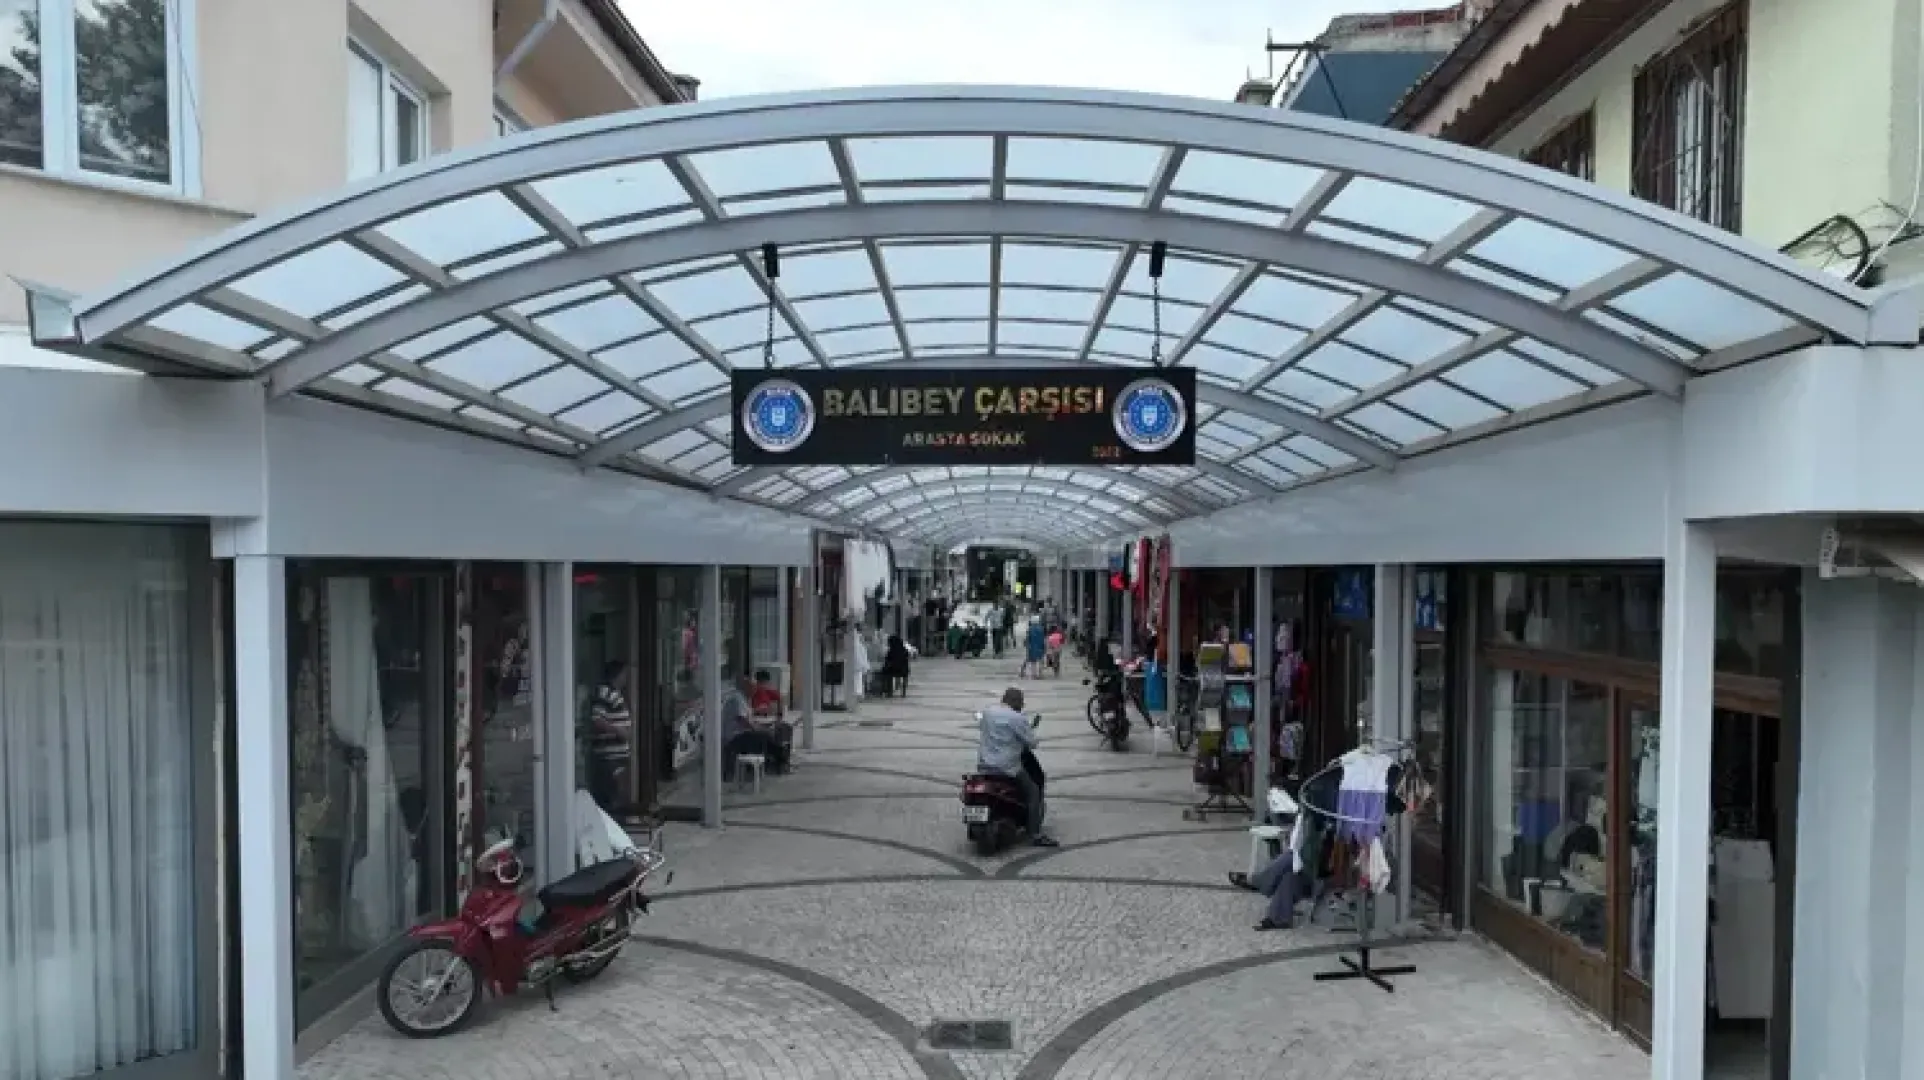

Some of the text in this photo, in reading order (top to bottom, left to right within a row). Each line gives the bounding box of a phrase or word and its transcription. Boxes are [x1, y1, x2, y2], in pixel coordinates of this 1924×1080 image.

[823, 386, 1104, 421] BALIBEY ÇARŞISI
[902, 430, 1026, 447] ARASTA SOKAK
